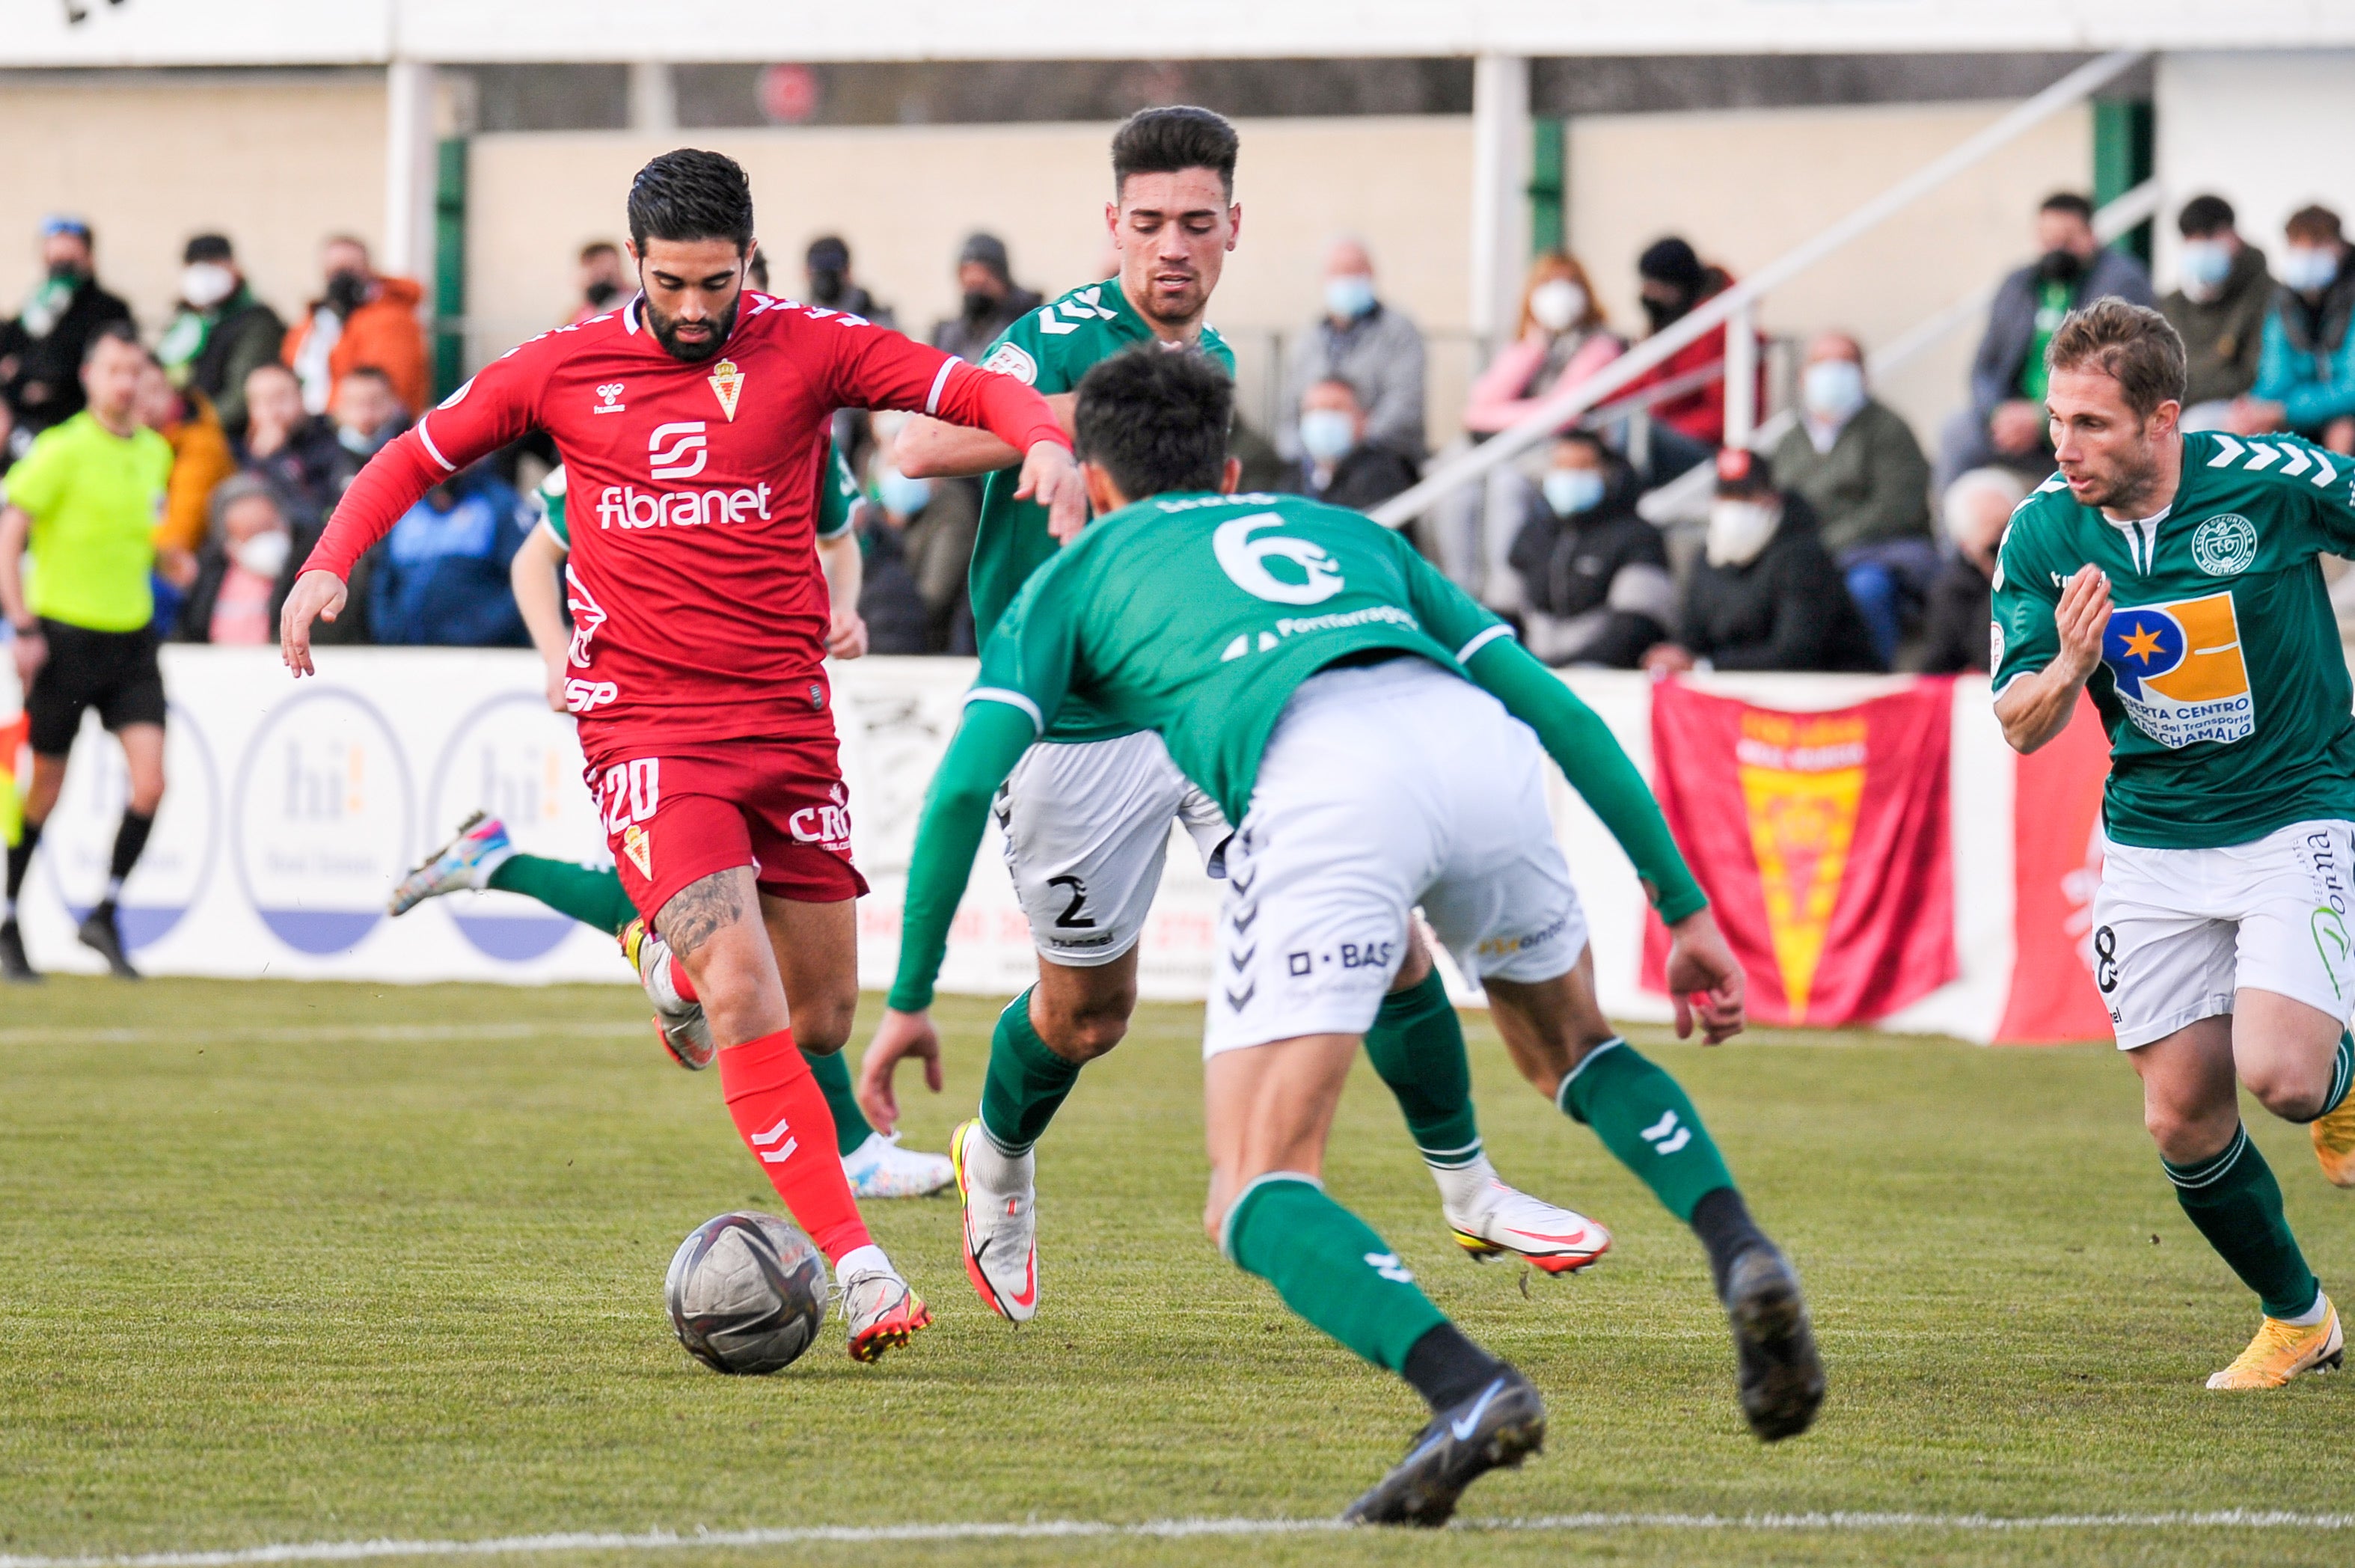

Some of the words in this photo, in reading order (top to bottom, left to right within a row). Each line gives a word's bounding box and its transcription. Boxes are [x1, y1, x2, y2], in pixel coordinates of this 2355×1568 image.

[596, 482, 771, 530] fibranet
[1213, 511, 1344, 605] 6
[2161, 723, 2181, 732] del
[2183, 714, 2250, 732] Transporte
[2176, 697, 2249, 720] CENTRO
[606, 757, 659, 835] 20
[1047, 875, 1096, 928] 2
[1341, 942, 1395, 968] BAS
[2095, 925, 2119, 993] 8
